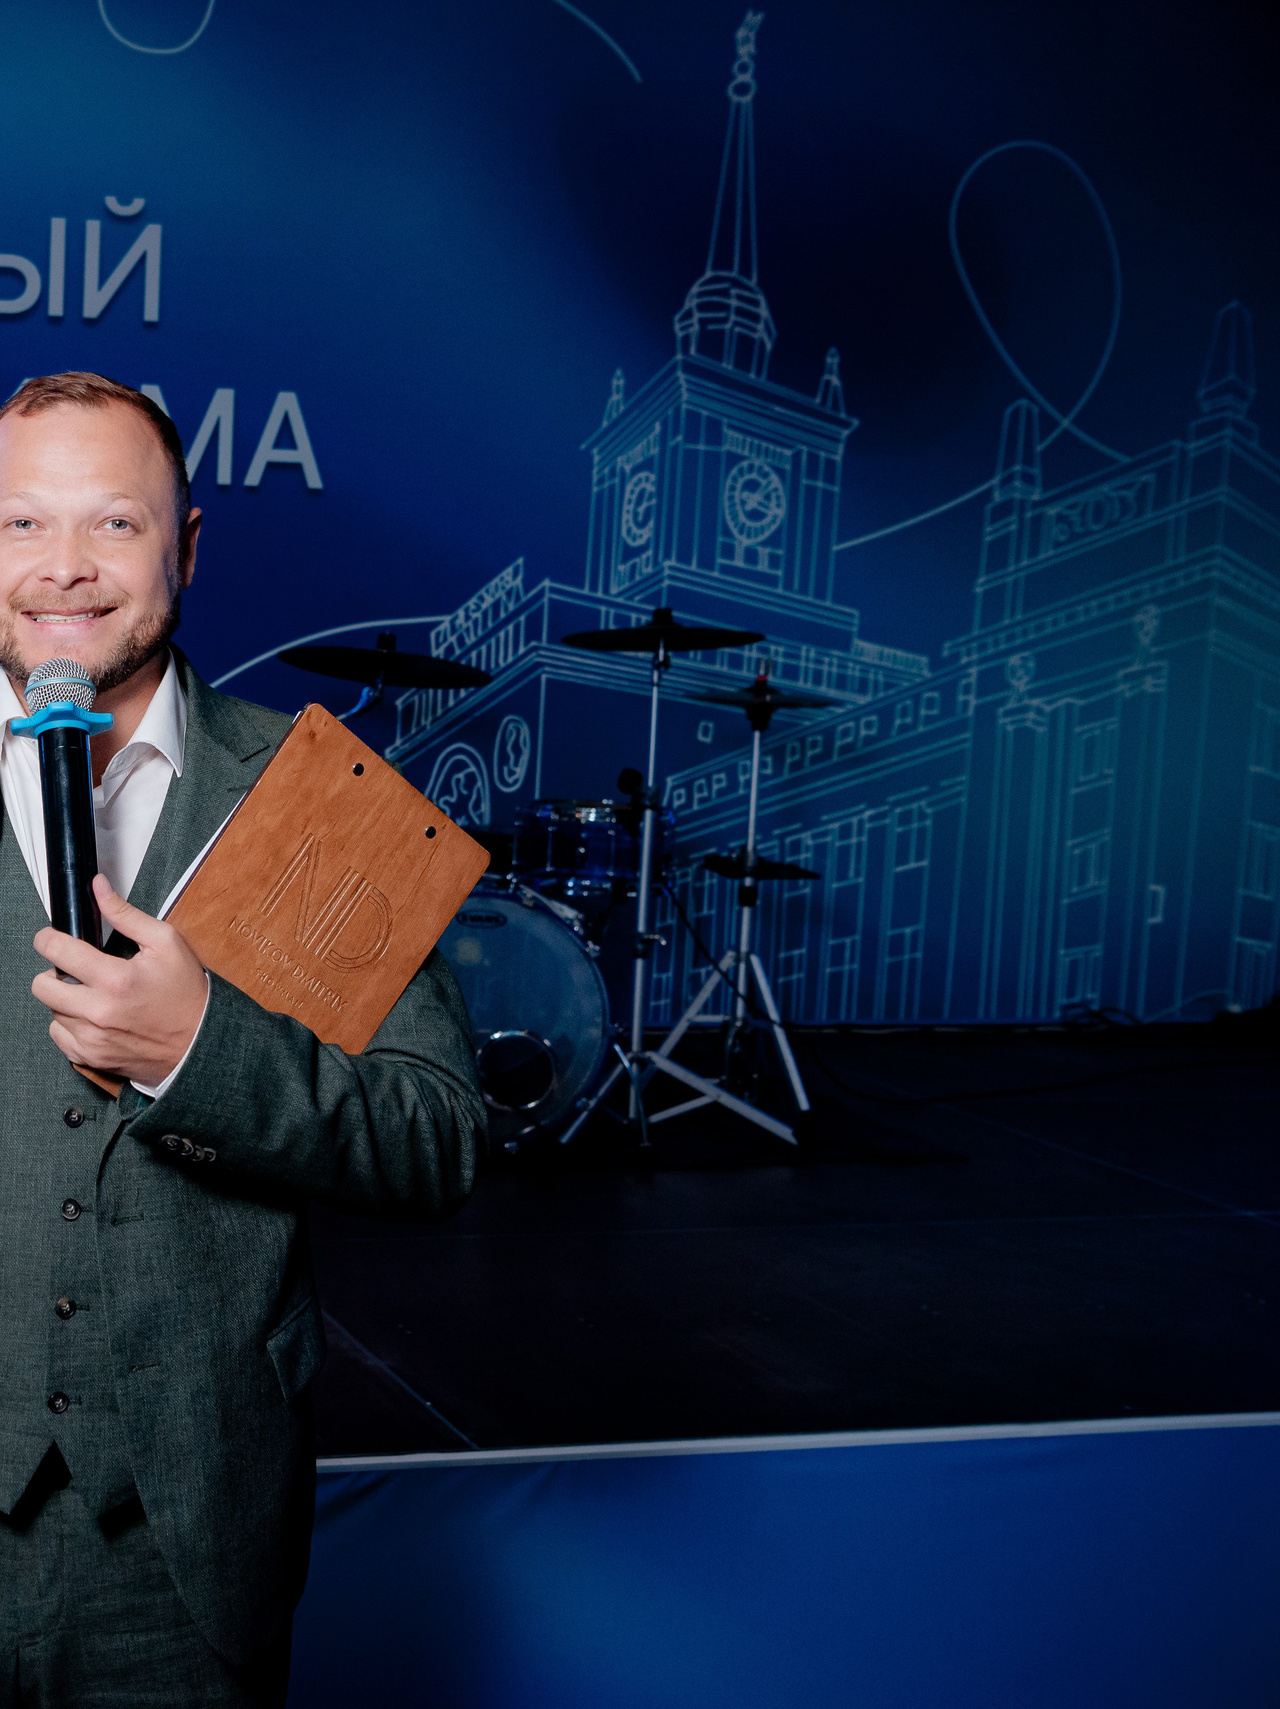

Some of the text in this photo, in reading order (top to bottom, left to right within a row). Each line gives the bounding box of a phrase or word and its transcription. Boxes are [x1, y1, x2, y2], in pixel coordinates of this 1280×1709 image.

[228, 915, 349, 1013] NOVIKOV DMITRIY
[254, 967, 305, 1009] SHOWMAN
